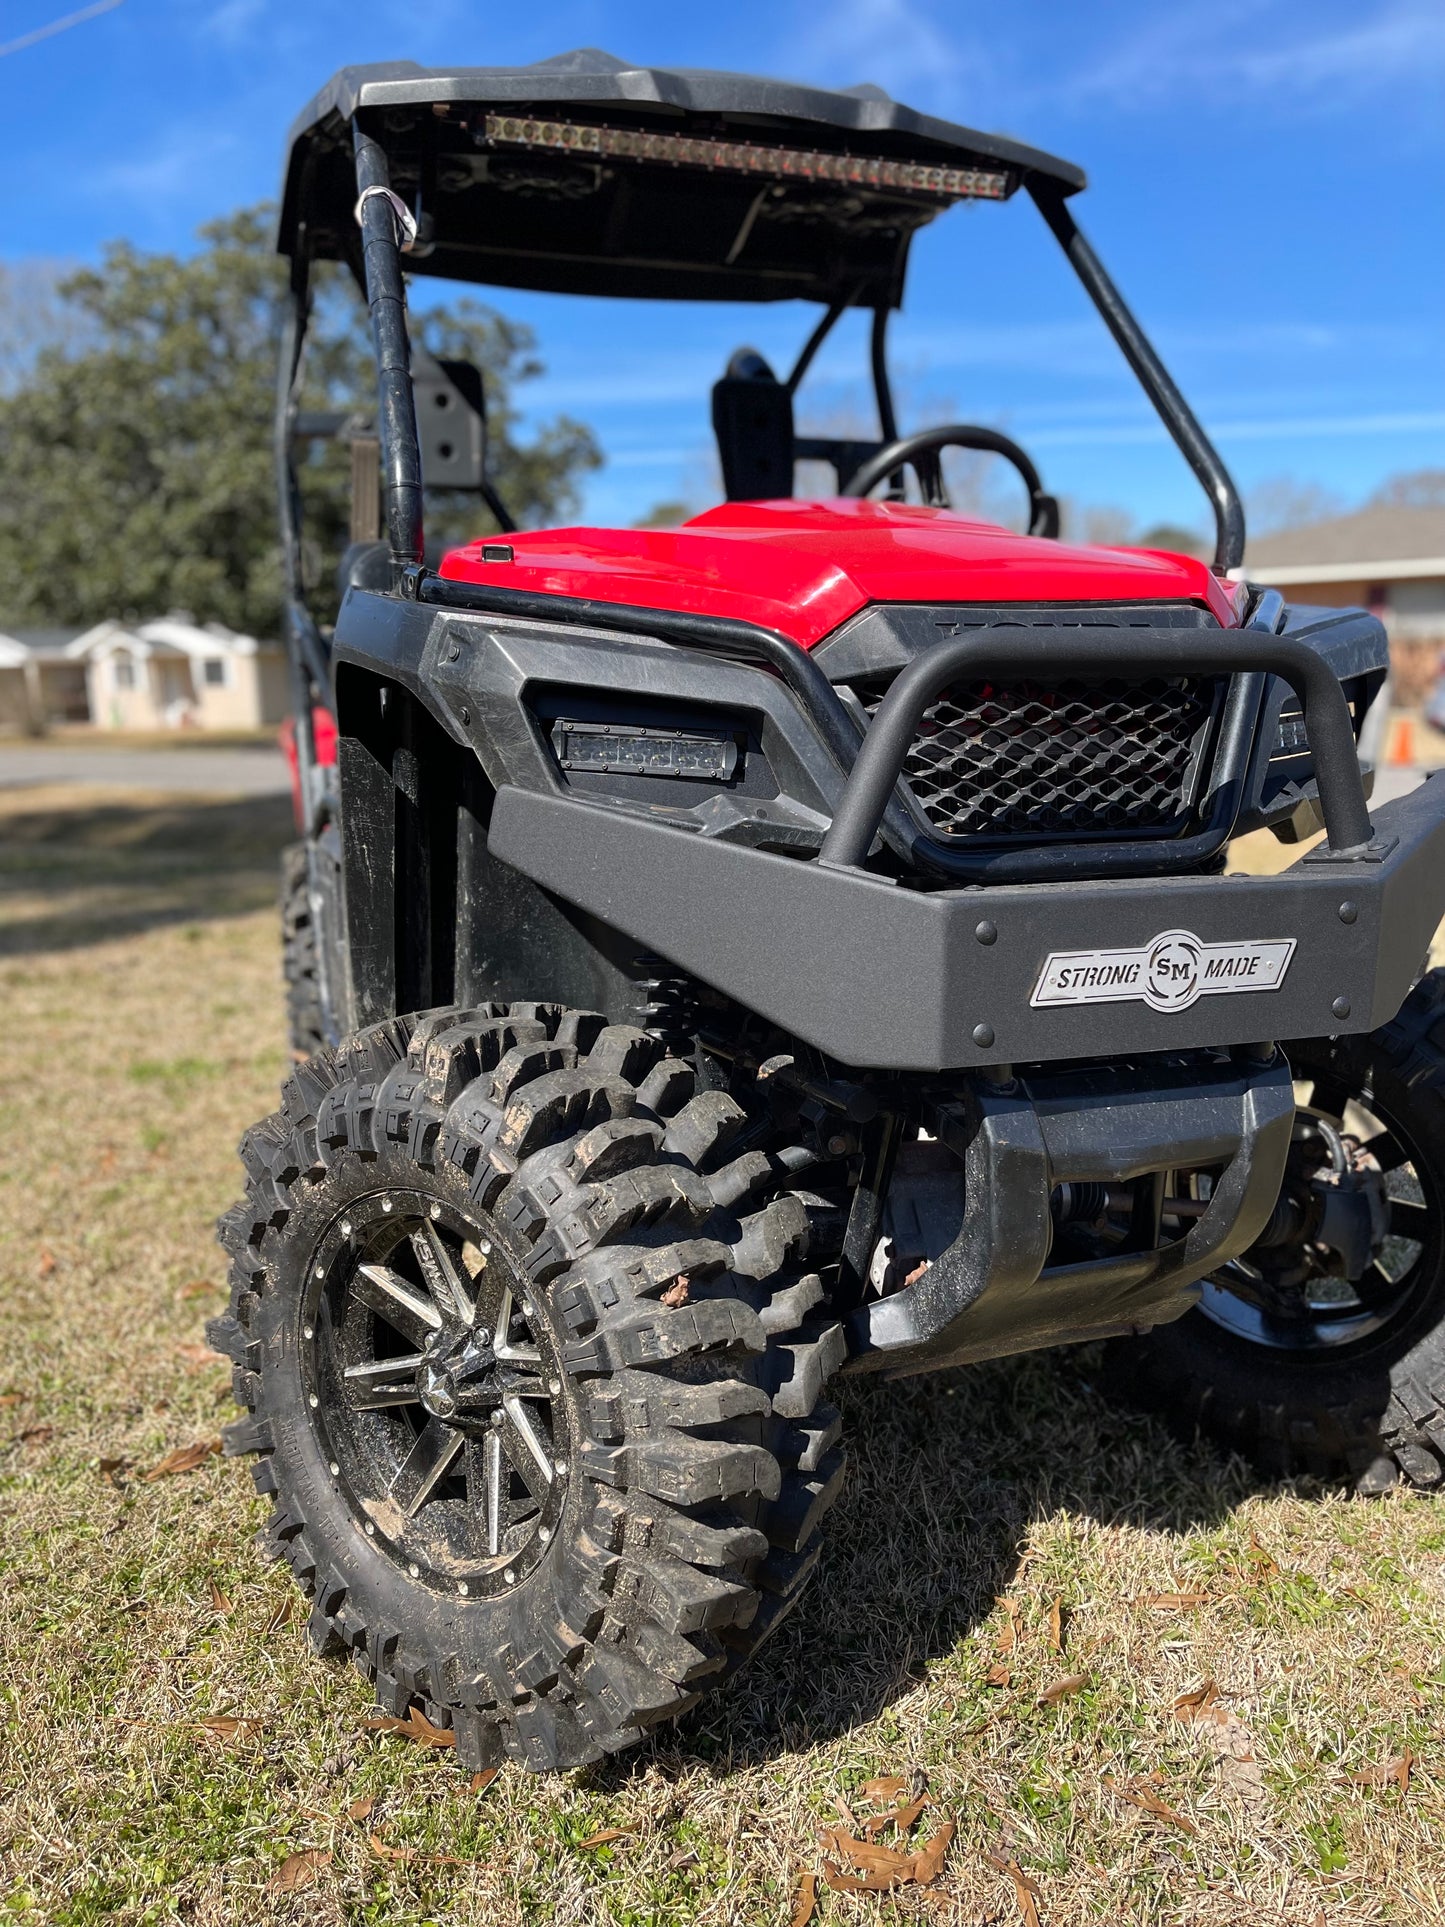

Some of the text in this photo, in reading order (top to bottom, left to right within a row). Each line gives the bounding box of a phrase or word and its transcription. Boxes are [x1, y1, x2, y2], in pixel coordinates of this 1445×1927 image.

[1057, 956, 1261, 989] STRONG SM MADE
